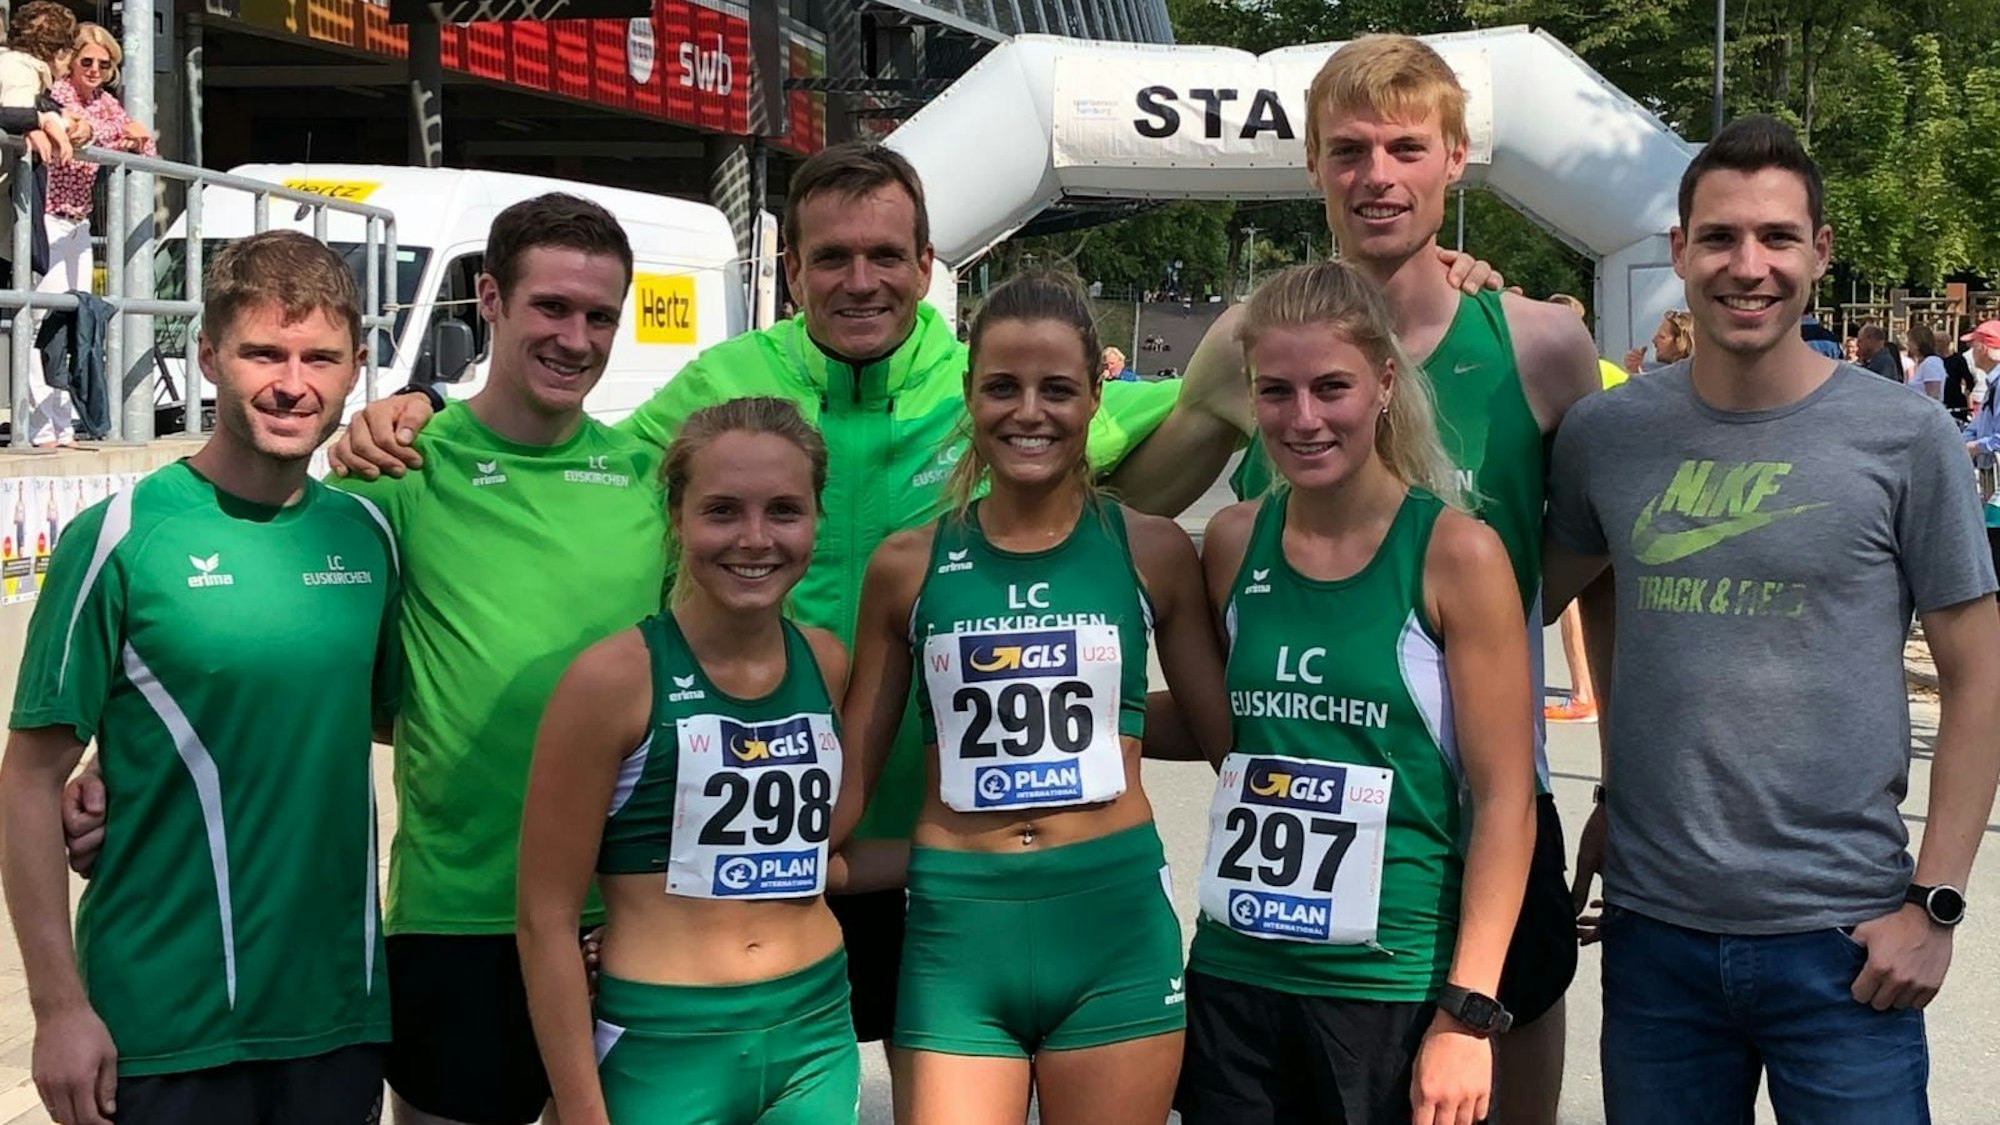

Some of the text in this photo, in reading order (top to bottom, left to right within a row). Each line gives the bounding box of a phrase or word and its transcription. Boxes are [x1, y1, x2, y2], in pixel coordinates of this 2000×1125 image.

[679, 33, 732, 95] swb
[1133, 85, 1310, 140] STA
[641, 287, 690, 328] Hertz
[588, 455, 609, 470] LC
[938, 445, 959, 465] LC
[472, 474, 507, 486] erima
[564, 470, 629, 487] EUSKIRCHEN
[1657, 459, 1793, 518] NIKE
[326, 554, 345, 571] LC
[938, 561, 974, 574] erima
[187, 572, 234, 588] erima
[302, 571, 372, 586] EUSKIRCHEN
[1008, 582, 1050, 610] LC
[1637, 575, 1708, 613] TRACK
[1709, 576, 1732, 615] &
[953, 613, 1106, 633] EUSKIRCHEN
[931, 653, 949, 673] W
[1022, 643, 1067, 669] GLS
[1083, 646, 1117, 662] U23
[1276, 645, 1327, 685] LC
[668, 689, 705, 702] erima
[953, 680, 1093, 760] 296
[1230, 690, 1389, 729] EUSKIRCHEN
[689, 734, 710, 753] W
[768, 732, 808, 758] GLS
[1014, 766, 1078, 790] PLAN
[1223, 770, 1239, 789] W
[1016, 788, 1078, 799] INTERNATIONAL
[1289, 776, 1335, 803] GLS
[1349, 786, 1385, 805] U23
[698, 768, 832, 846] 298
[1217, 807, 1357, 893] 297
[760, 857, 815, 878] PLAN
[1264, 900, 1326, 926] PLAN
